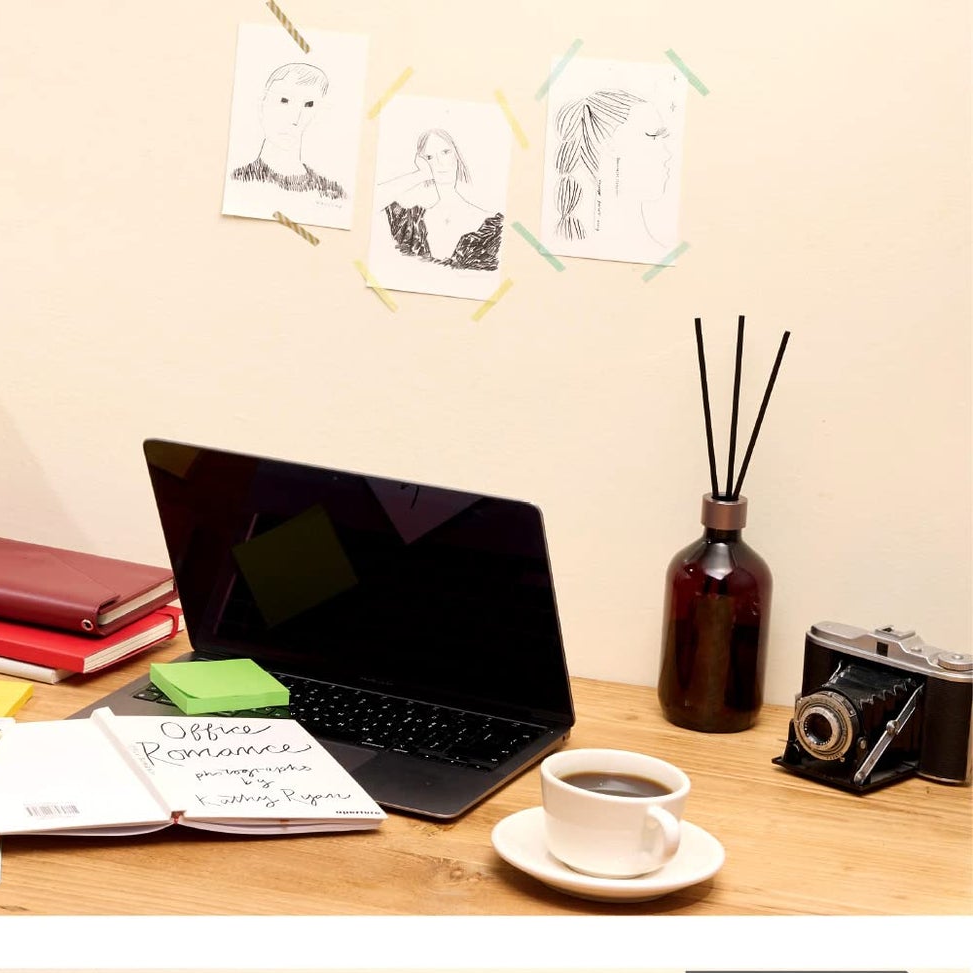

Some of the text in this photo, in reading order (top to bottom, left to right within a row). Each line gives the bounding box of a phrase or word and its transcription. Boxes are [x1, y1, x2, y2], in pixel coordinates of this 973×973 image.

[160, 721, 272, 741] Office
[135, 741, 313, 767] Romance
[195, 763, 313, 781] photographs
[240, 777, 275, 789] by
[195, 788, 352, 808] Kathy Ryan
